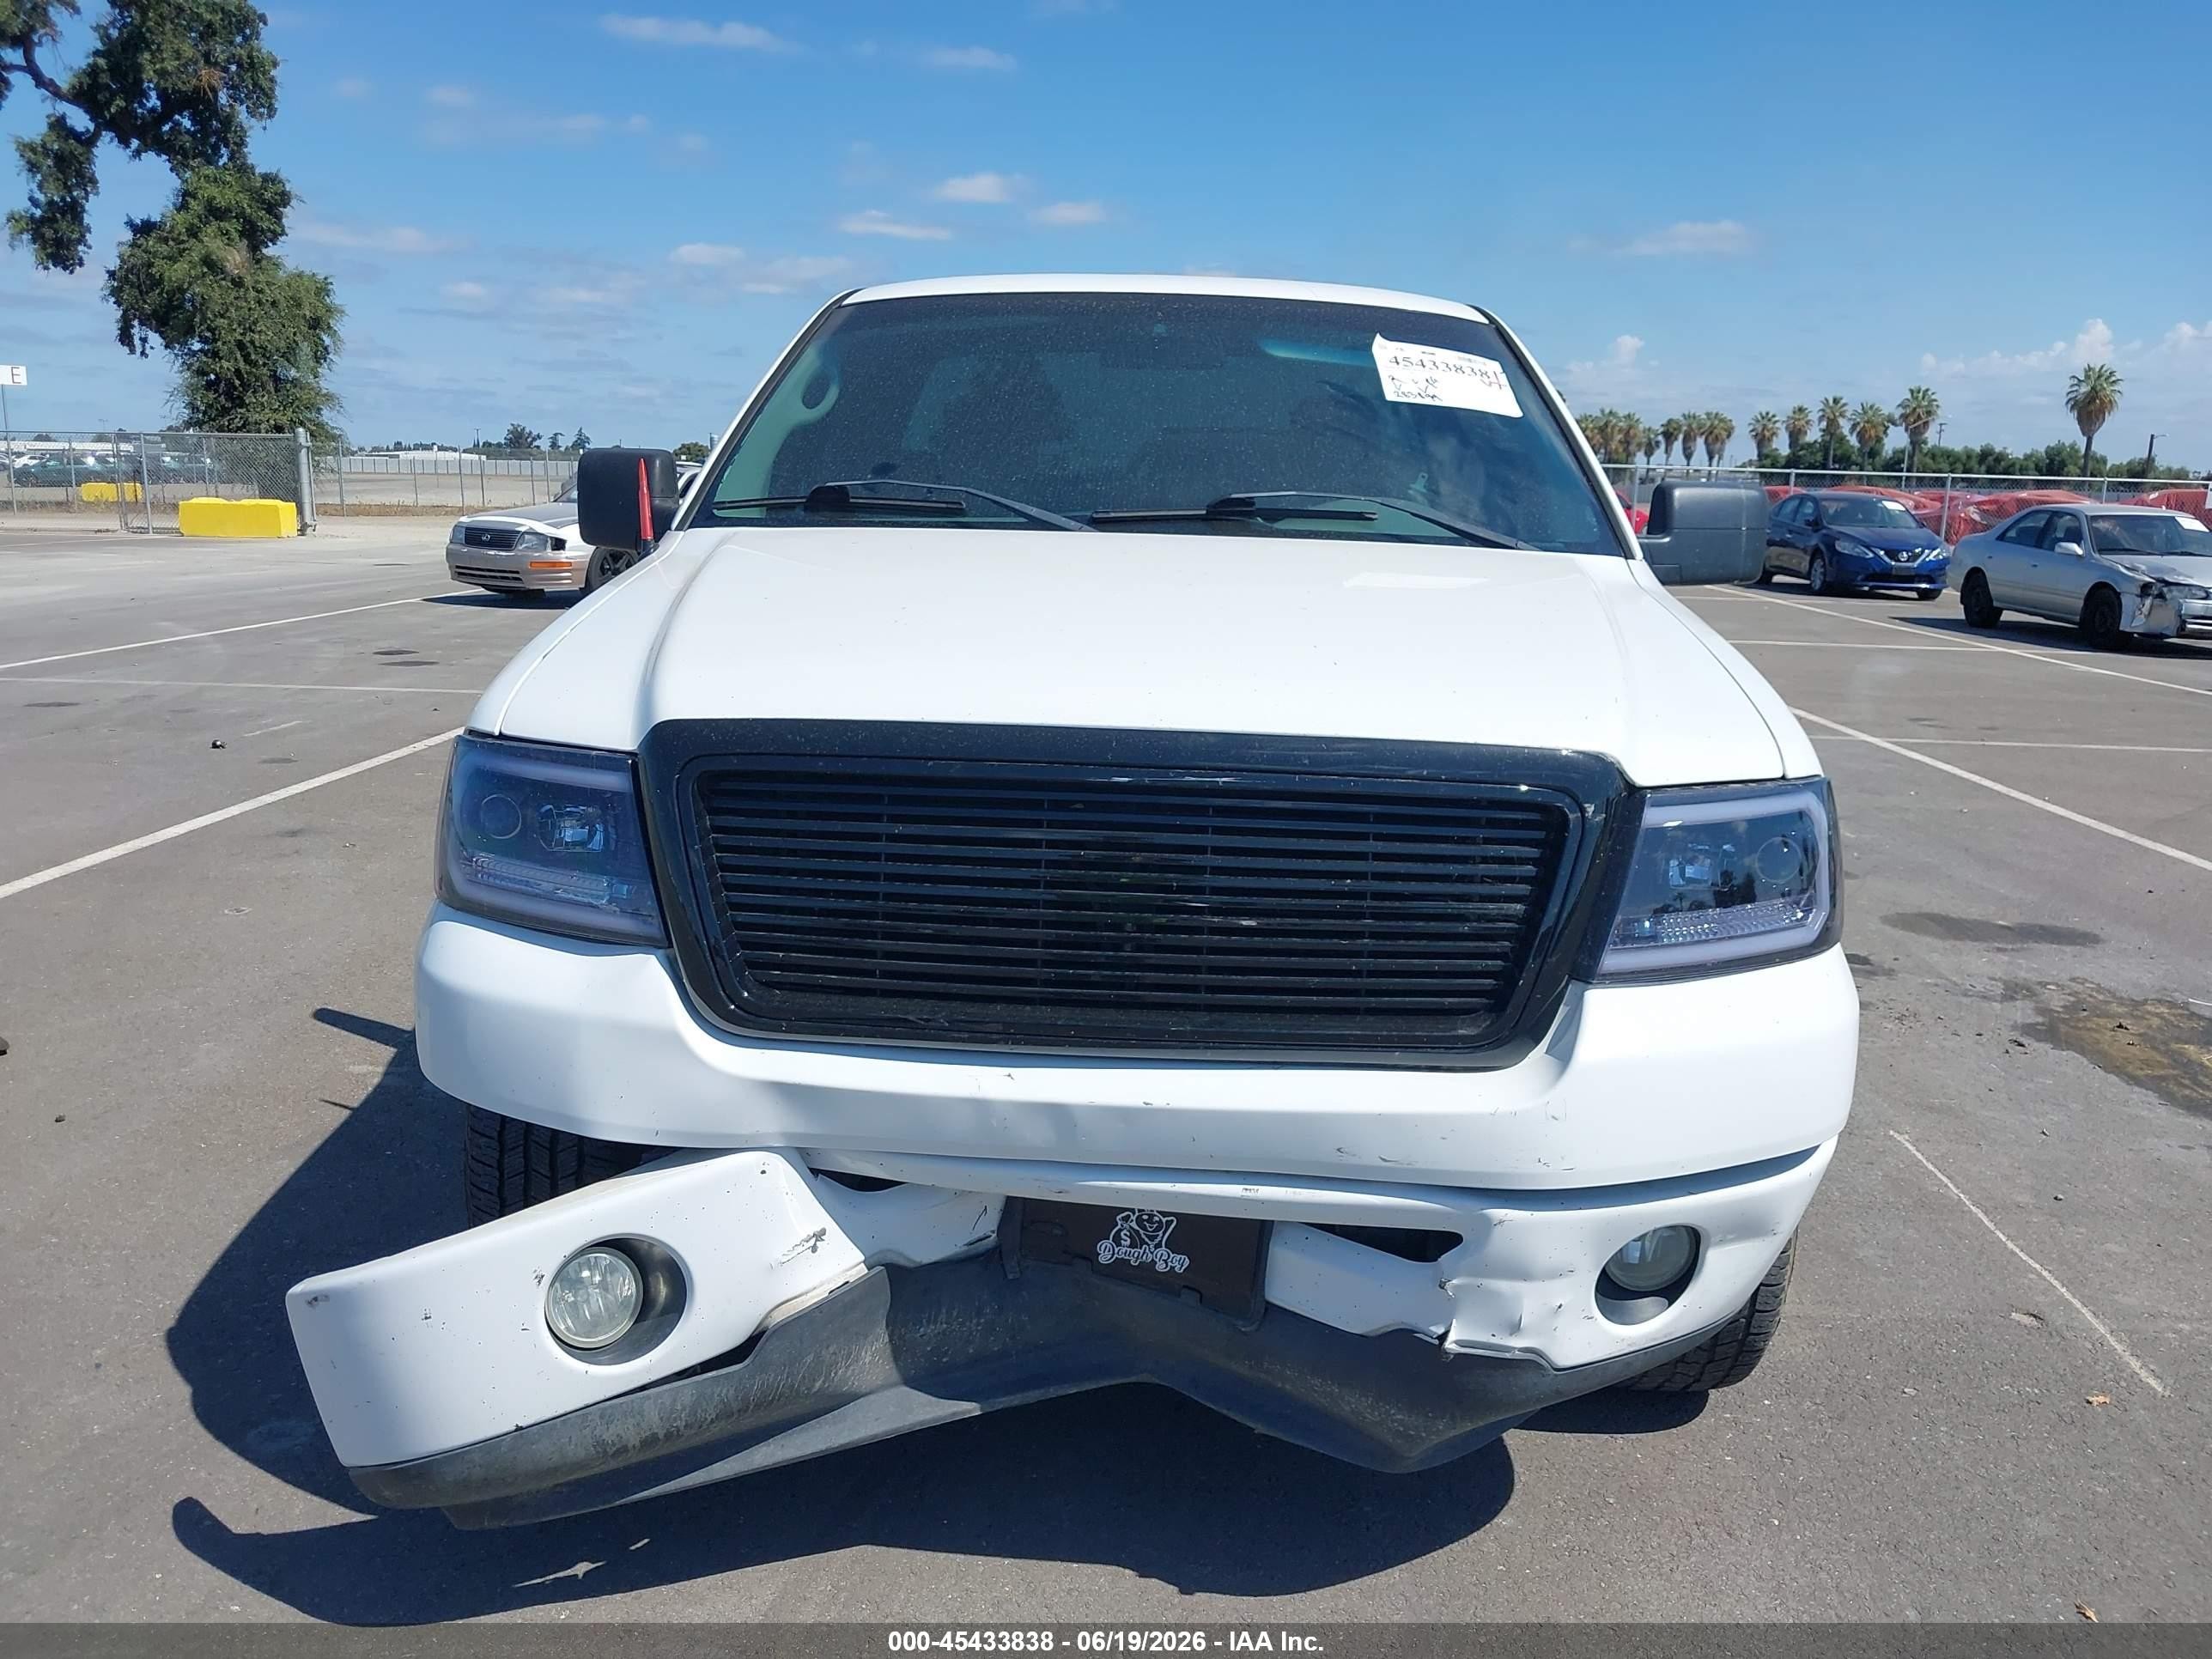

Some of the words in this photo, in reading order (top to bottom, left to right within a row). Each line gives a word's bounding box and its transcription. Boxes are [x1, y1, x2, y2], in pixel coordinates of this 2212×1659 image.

[10, 366, 21, 385] E
[1389, 356, 1491, 380] 45433838
[1097, 1239, 1152, 1266] Dough
[1153, 1248, 1190, 1273] Boy
